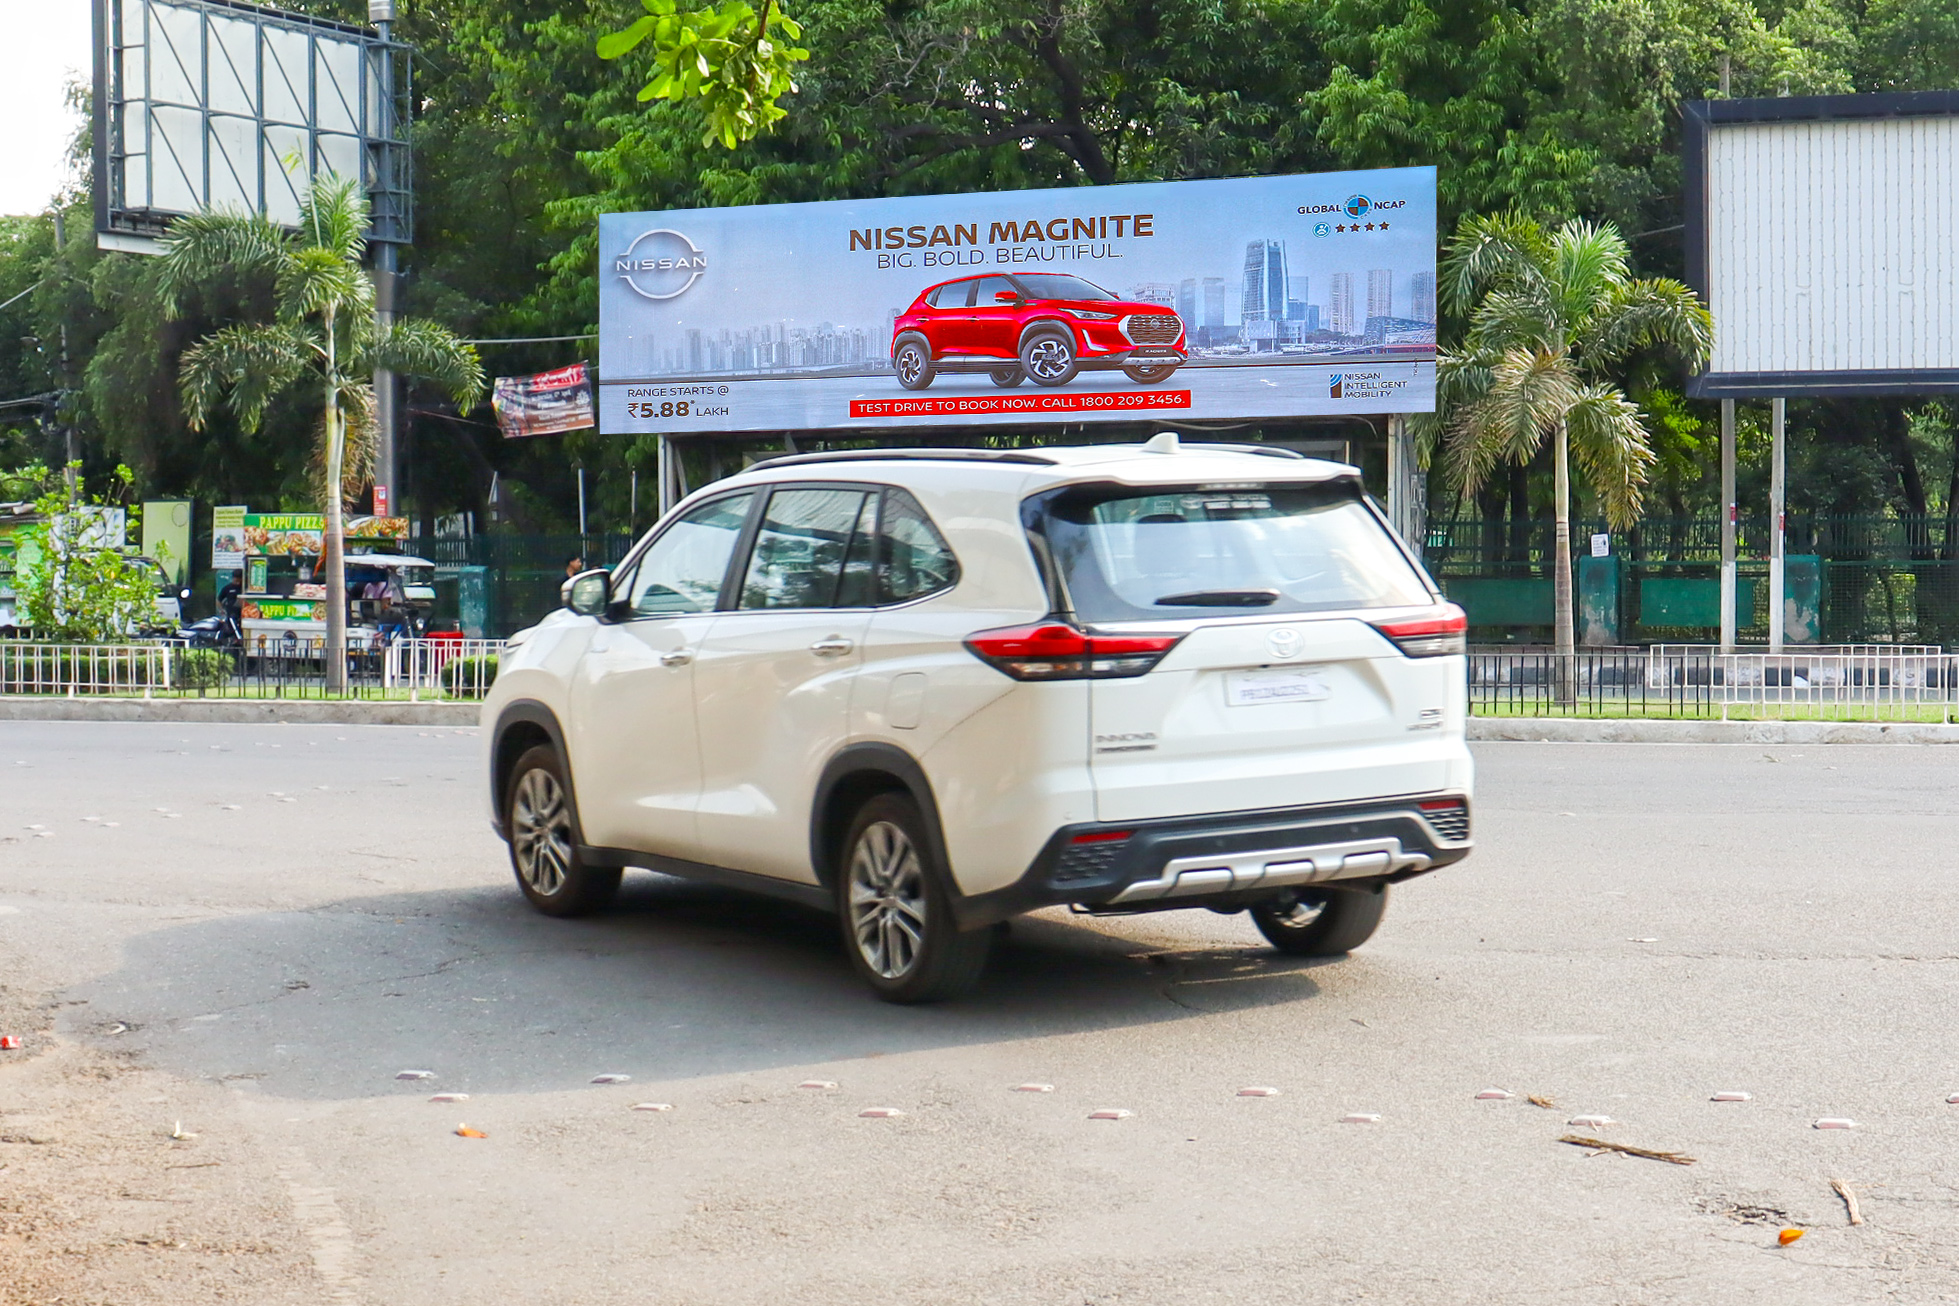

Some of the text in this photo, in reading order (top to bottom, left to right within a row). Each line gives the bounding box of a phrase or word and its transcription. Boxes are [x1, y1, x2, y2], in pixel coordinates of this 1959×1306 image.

[1297, 200, 1406, 215] GLOBAL NCAP
[849, 213, 1154, 252] NISSAN MAGNITE
[877, 243, 1124, 269] BIG. BOLD. BEAUTIFUL.
[616, 256, 707, 271] NISSAN
[1344, 372, 1381, 380] NISSAN
[627, 385, 729, 397] RANGE STARTS @
[1344, 380, 1408, 390] INTELLIGENT
[1344, 390, 1392, 398] MOBILITY
[858, 394, 1186, 413] TEST DRIVE TO BOOK NOW. CALL 1800 209 3456.
[696, 407, 729, 417] LAKH
[260, 516, 292, 529] PAPPU
